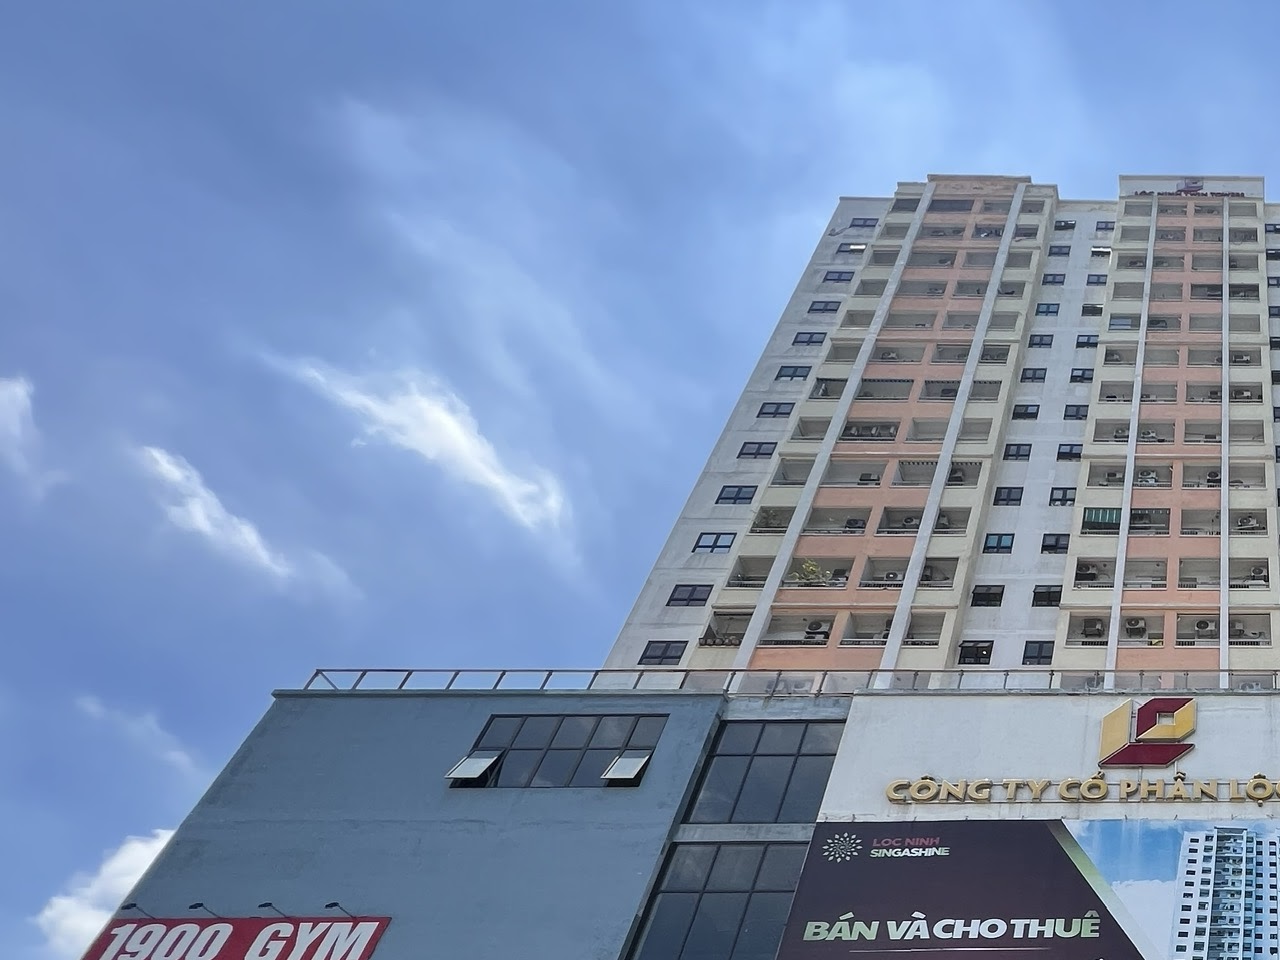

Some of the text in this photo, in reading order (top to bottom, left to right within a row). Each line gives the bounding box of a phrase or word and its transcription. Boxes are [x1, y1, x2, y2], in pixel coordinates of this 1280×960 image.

[886, 775, 992, 802] CÔNG
[1002, 777, 1052, 801] TY
[1058, 770, 1108, 801] CỔ
[1119, 771, 1220, 801] PHẦN
[869, 846, 950, 858] SINGASHINE
[904, 837, 940, 846] NINH
[802, 909, 1102, 941] BÁN VÀ CHO THUÊ
